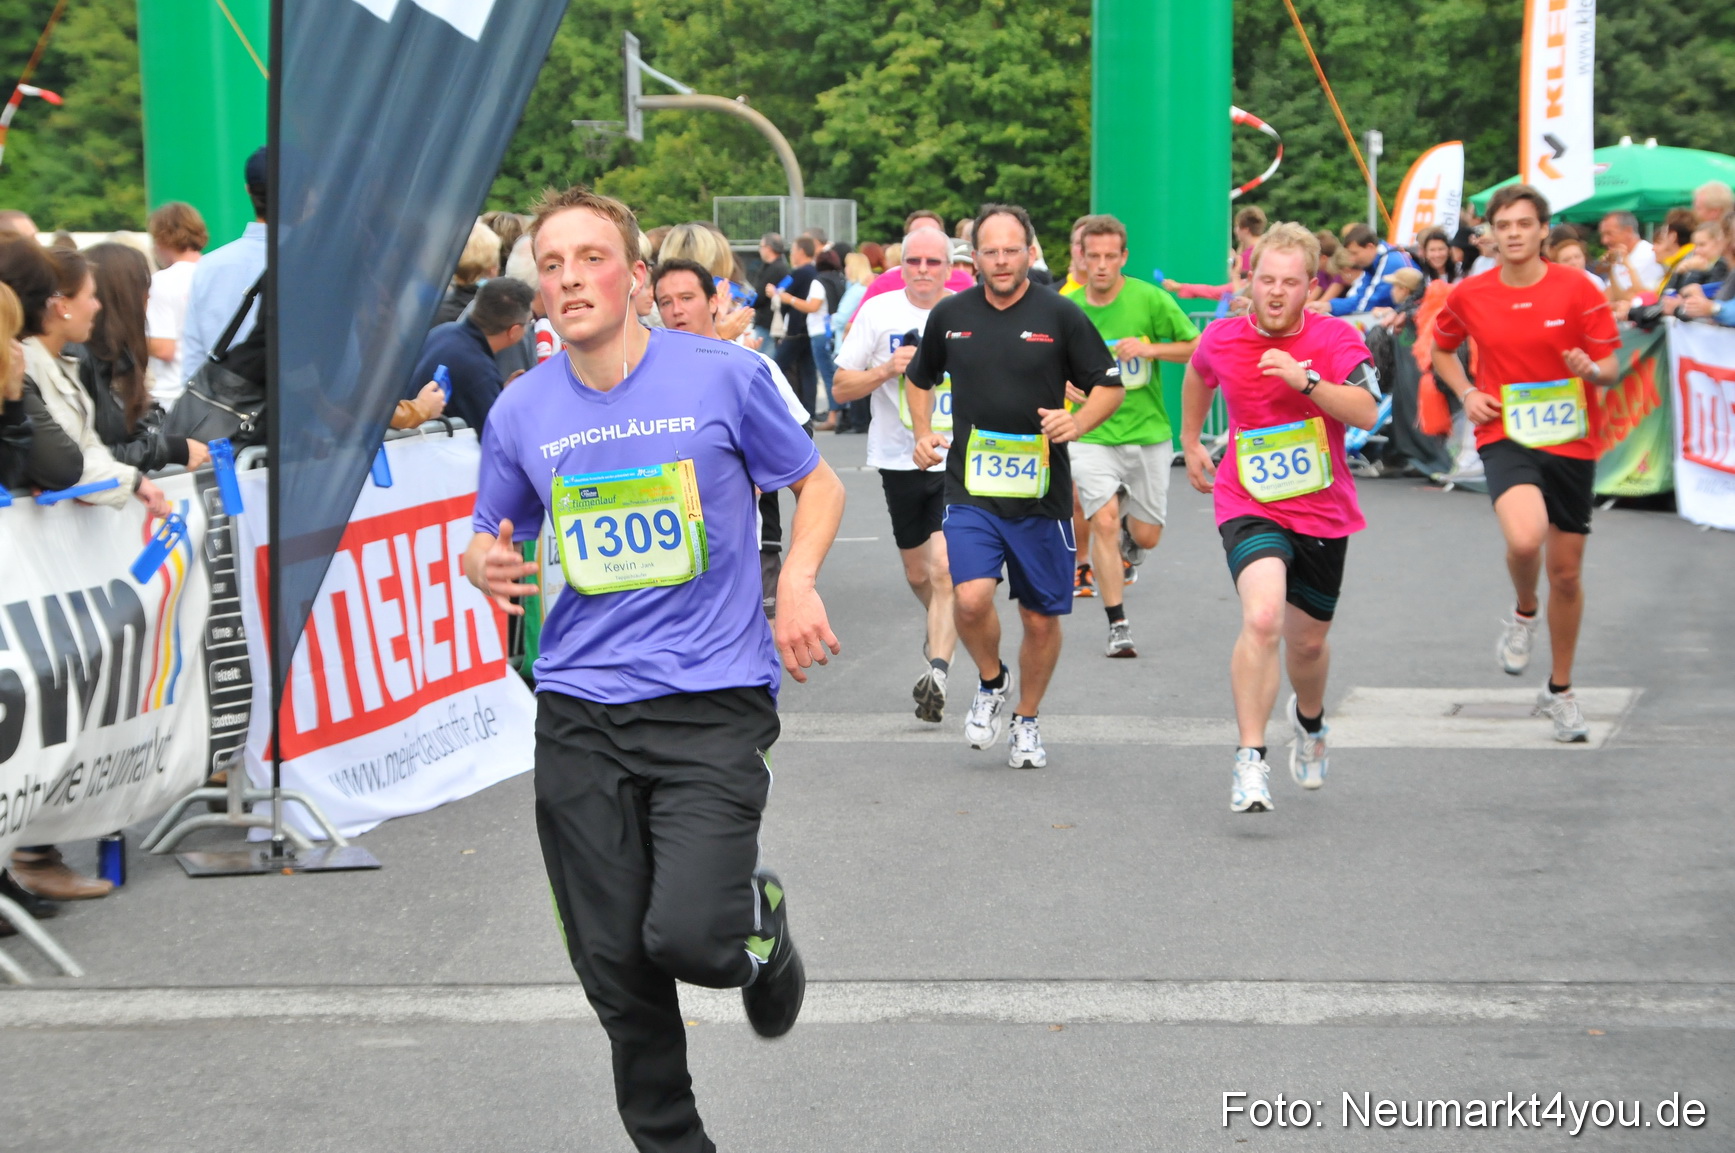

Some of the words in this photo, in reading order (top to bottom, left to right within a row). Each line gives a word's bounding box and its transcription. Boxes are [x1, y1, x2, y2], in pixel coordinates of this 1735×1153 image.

[1546, 0, 1567, 118] KLE
[1511, 402, 1576, 430] 1142
[540, 417, 695, 459] TEPPICHLÄUFER
[972, 453, 1037, 480] 1354
[1249, 447, 1311, 484] 336
[572, 494, 618, 509] firmenlauf
[565, 509, 682, 560] 1309
[604, 560, 637, 573] Kevin
[281, 514, 504, 735] MEIER
